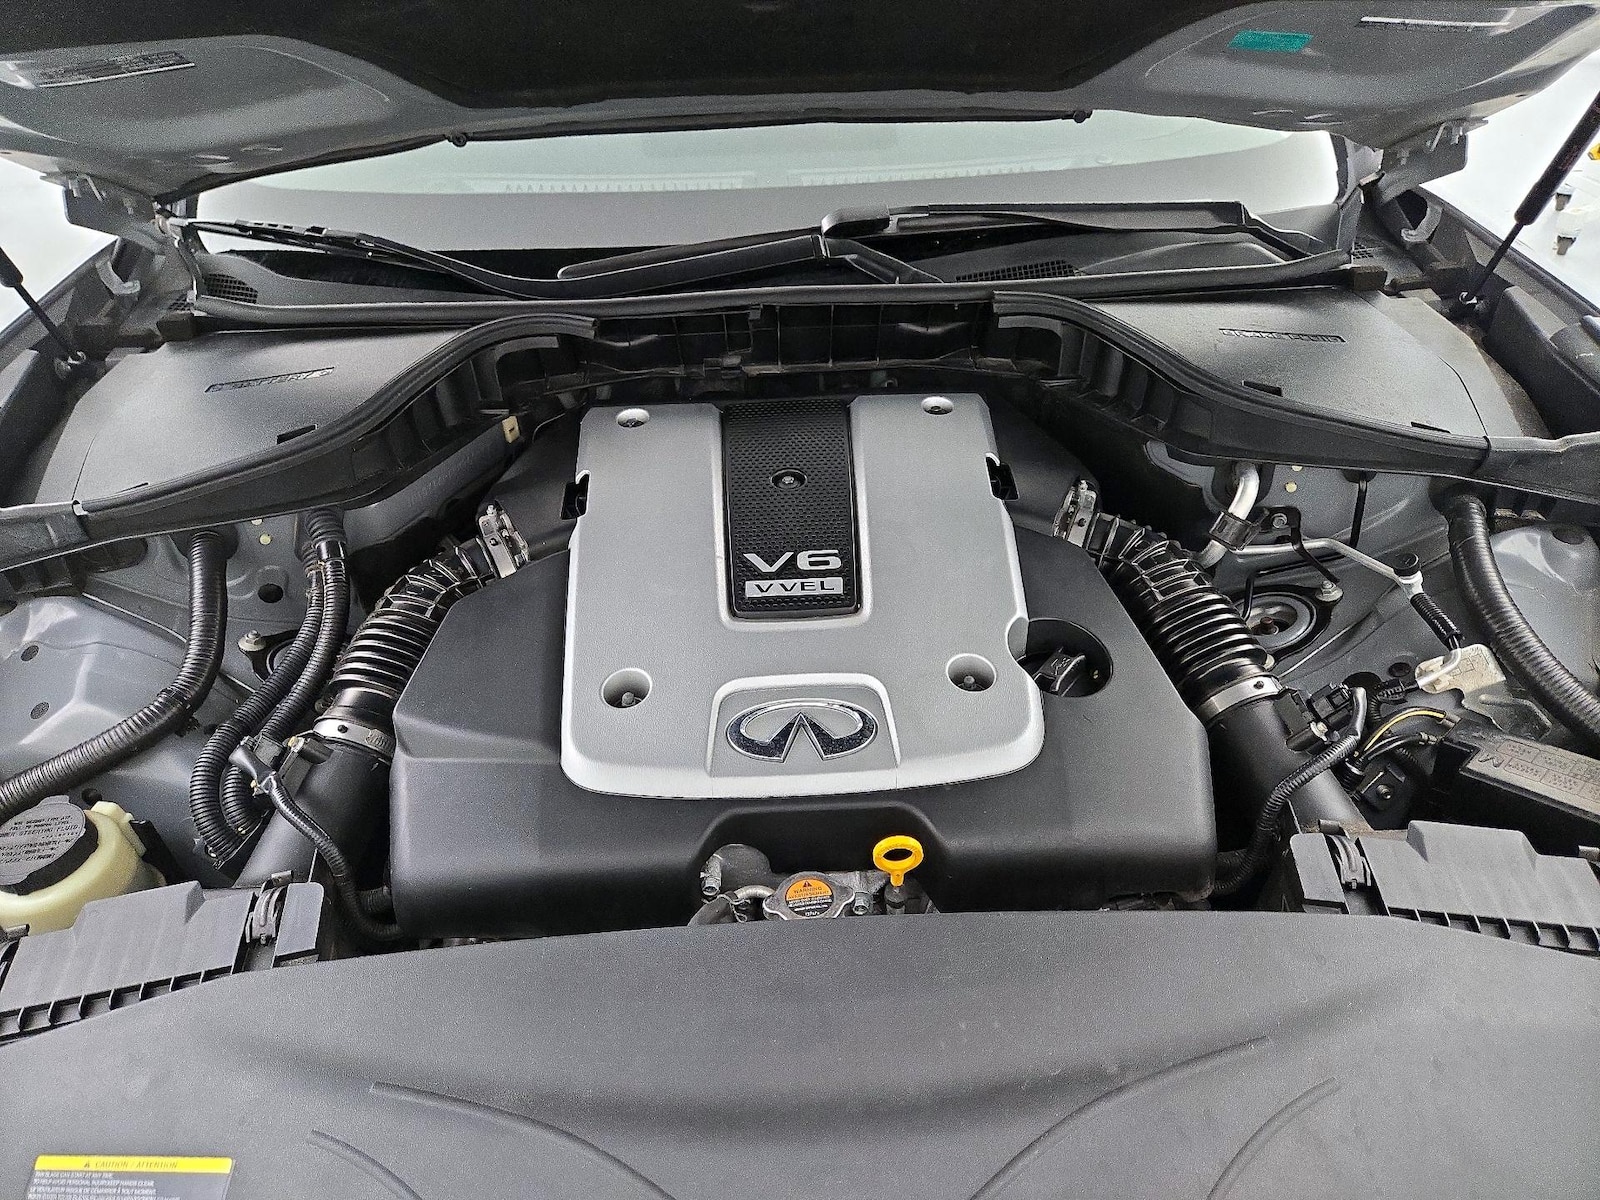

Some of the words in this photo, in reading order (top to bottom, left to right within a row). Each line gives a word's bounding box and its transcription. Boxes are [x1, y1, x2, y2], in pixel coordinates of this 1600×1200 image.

[743, 549, 842, 573] V6
[754, 580, 835, 593] VVEL
[95, 1160, 129, 1169] CAUTION
[136, 1161, 178, 1169] ATTENTION
